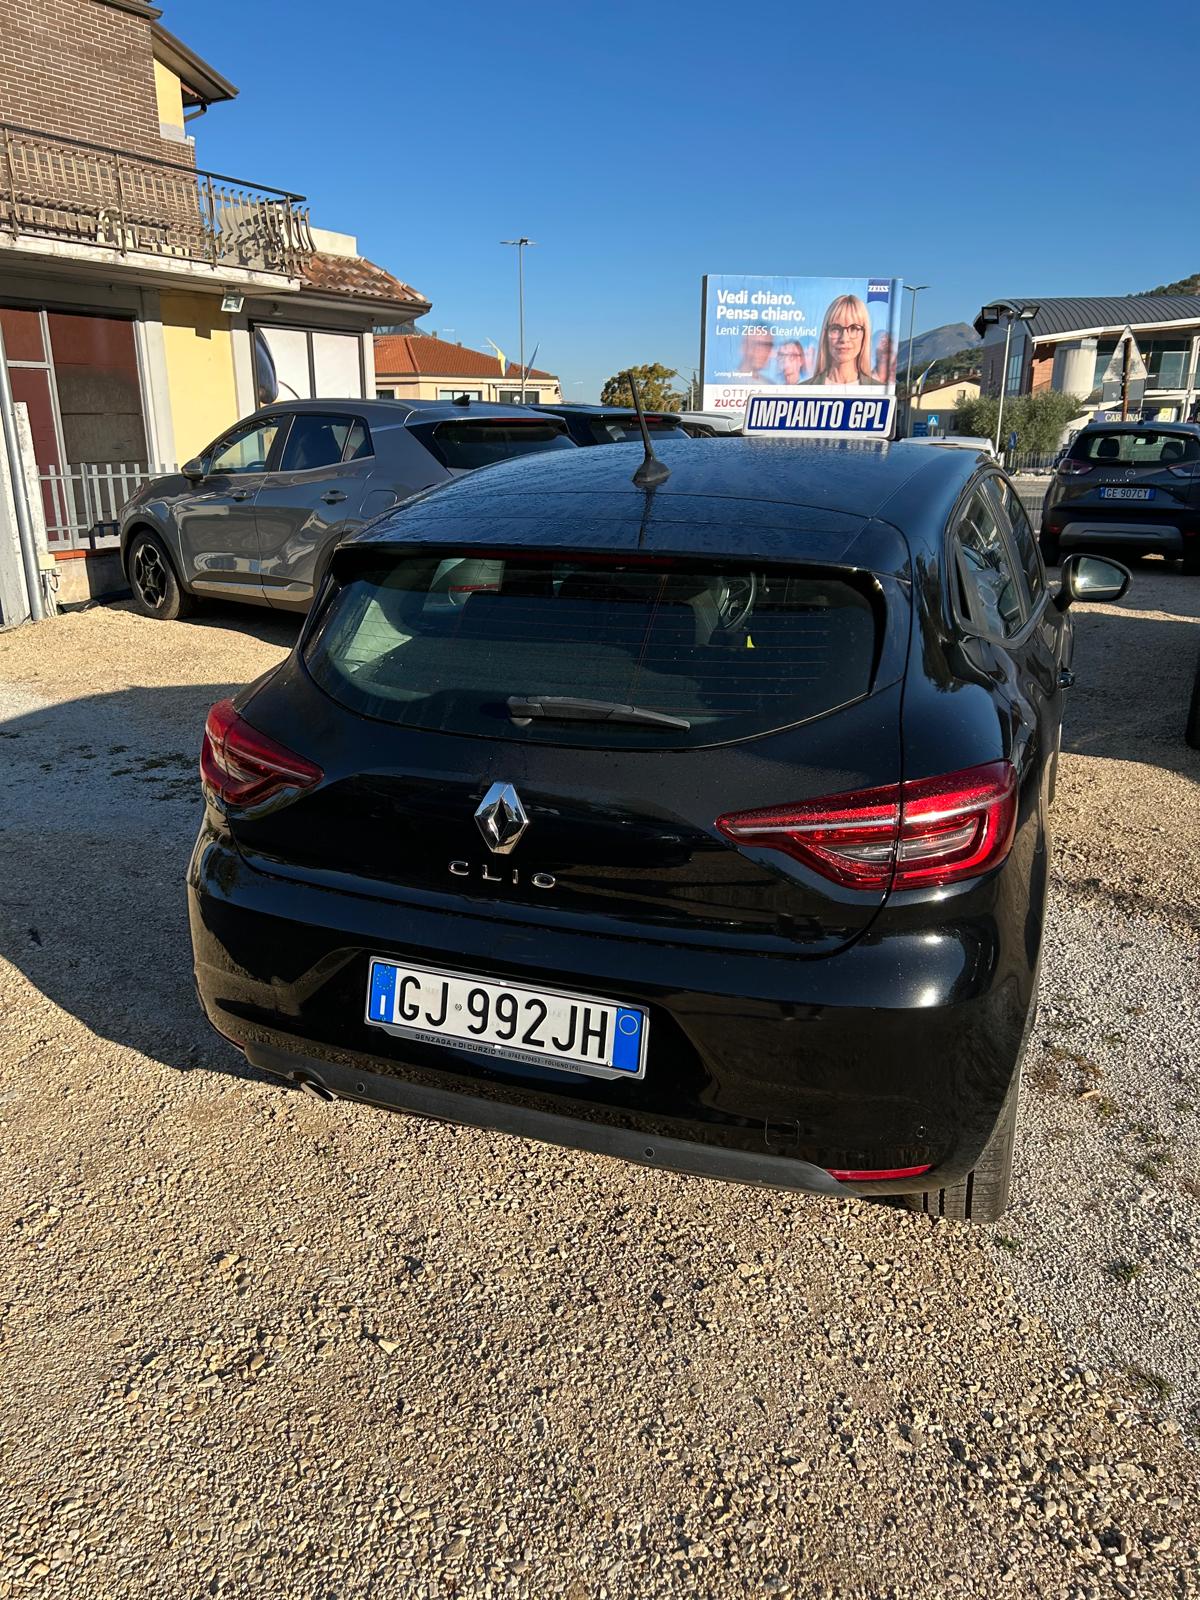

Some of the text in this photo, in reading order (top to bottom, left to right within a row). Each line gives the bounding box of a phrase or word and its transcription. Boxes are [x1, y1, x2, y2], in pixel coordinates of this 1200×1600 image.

[717, 289, 795, 305] Vedi chiaro.
[717, 305, 806, 321] Pensa chiaro.
[716, 325, 818, 337] Lenti ZEISS ClearMind
[750, 400, 885, 429] IMPIANTO GPL
[448, 860, 556, 888] CLIO
[398, 975, 449, 1027] GJ
